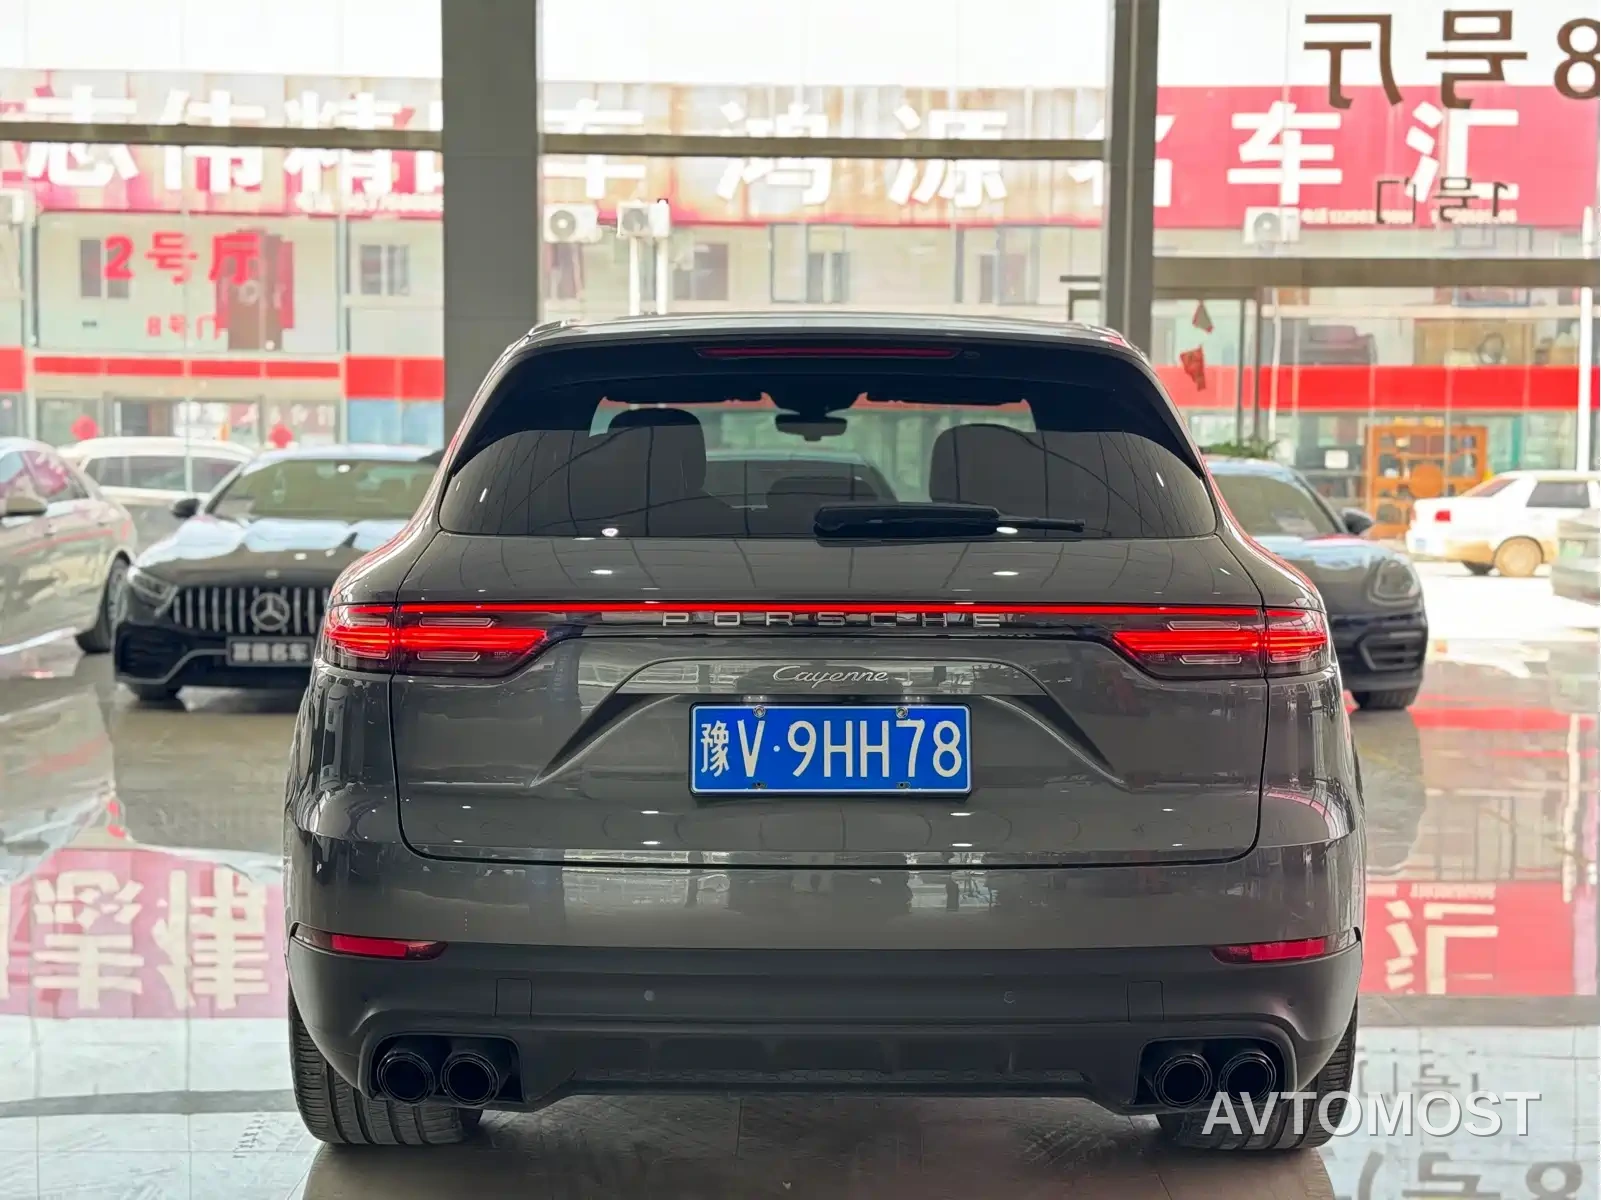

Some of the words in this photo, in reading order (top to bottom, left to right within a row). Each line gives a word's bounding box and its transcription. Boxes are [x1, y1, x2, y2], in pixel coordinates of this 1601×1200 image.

[25, 84, 646, 199] 志伟精车
[662, 611, 1001, 628] PORSCHE
[771, 664, 889, 688] Cayenne
[700, 719, 962, 778] 豫V·9HH78
